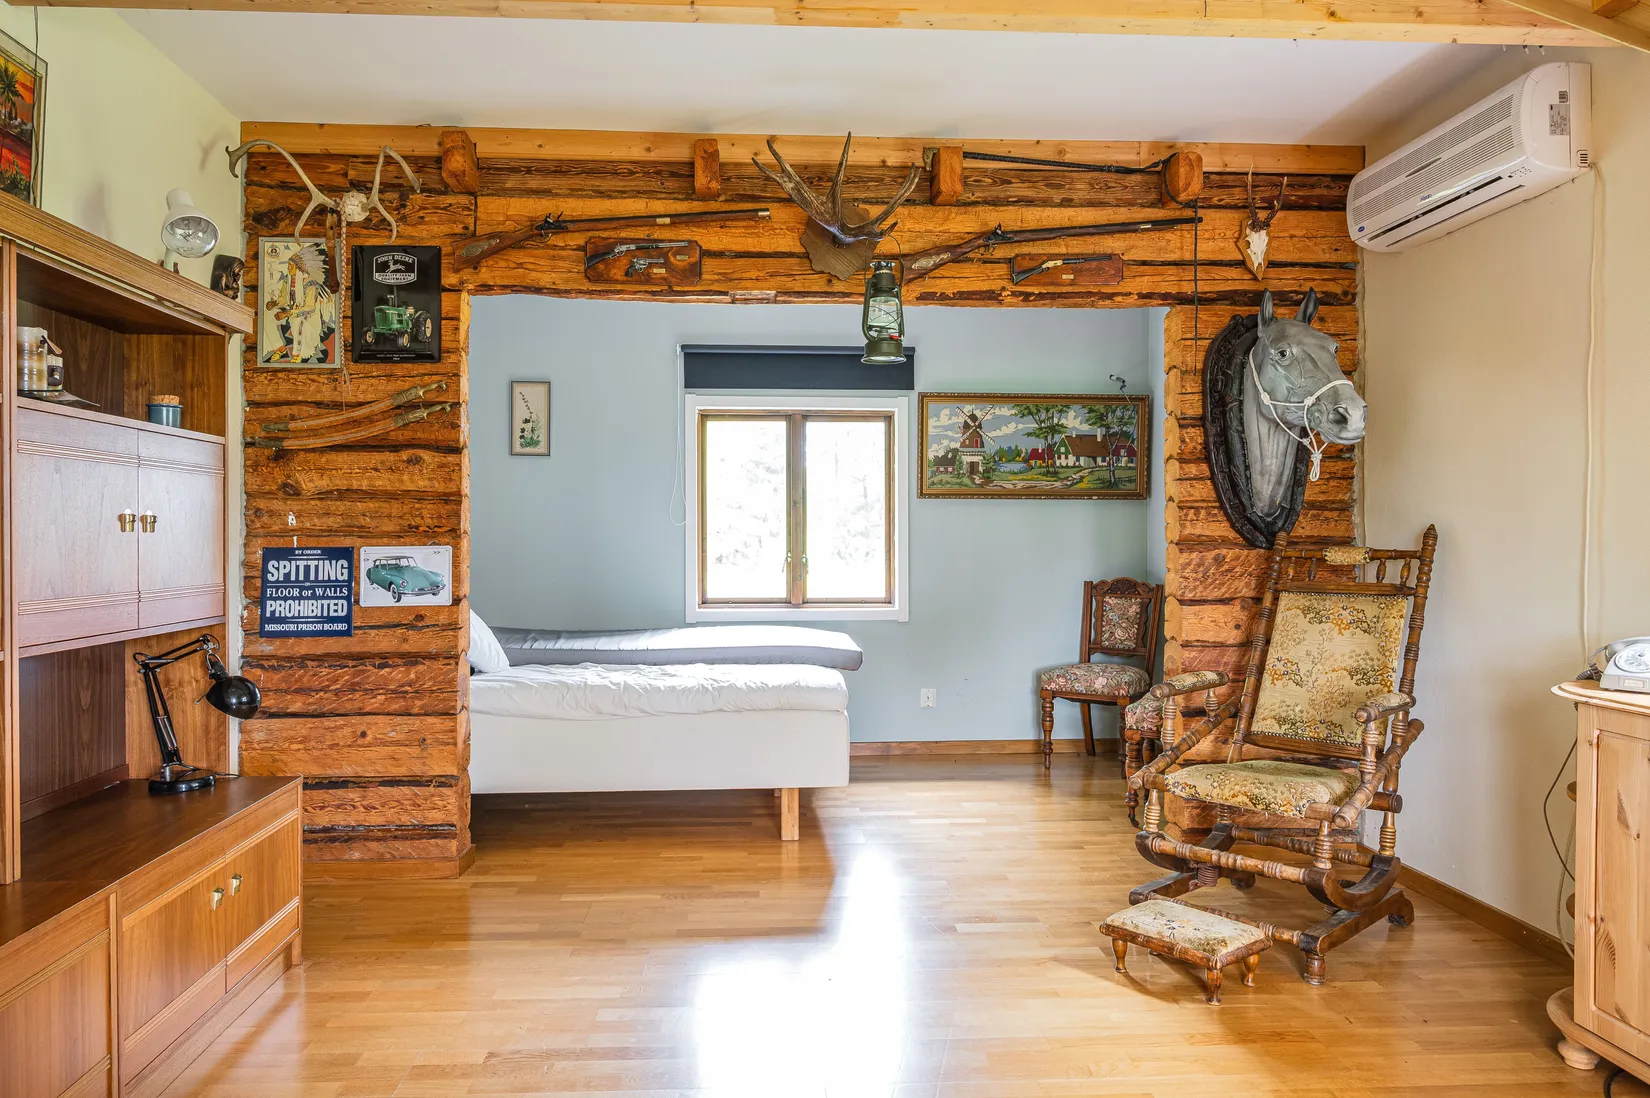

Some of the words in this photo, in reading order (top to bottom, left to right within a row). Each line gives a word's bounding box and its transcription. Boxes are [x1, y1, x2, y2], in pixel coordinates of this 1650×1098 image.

[377, 255, 393, 263] JOHN
[394, 255, 413, 263] DEERE
[267, 560, 348, 581] SPITTING
[266, 588, 300, 597] FLOOR
[315, 587, 348, 596] WALLS
[266, 600, 348, 617] PROHIBITED
